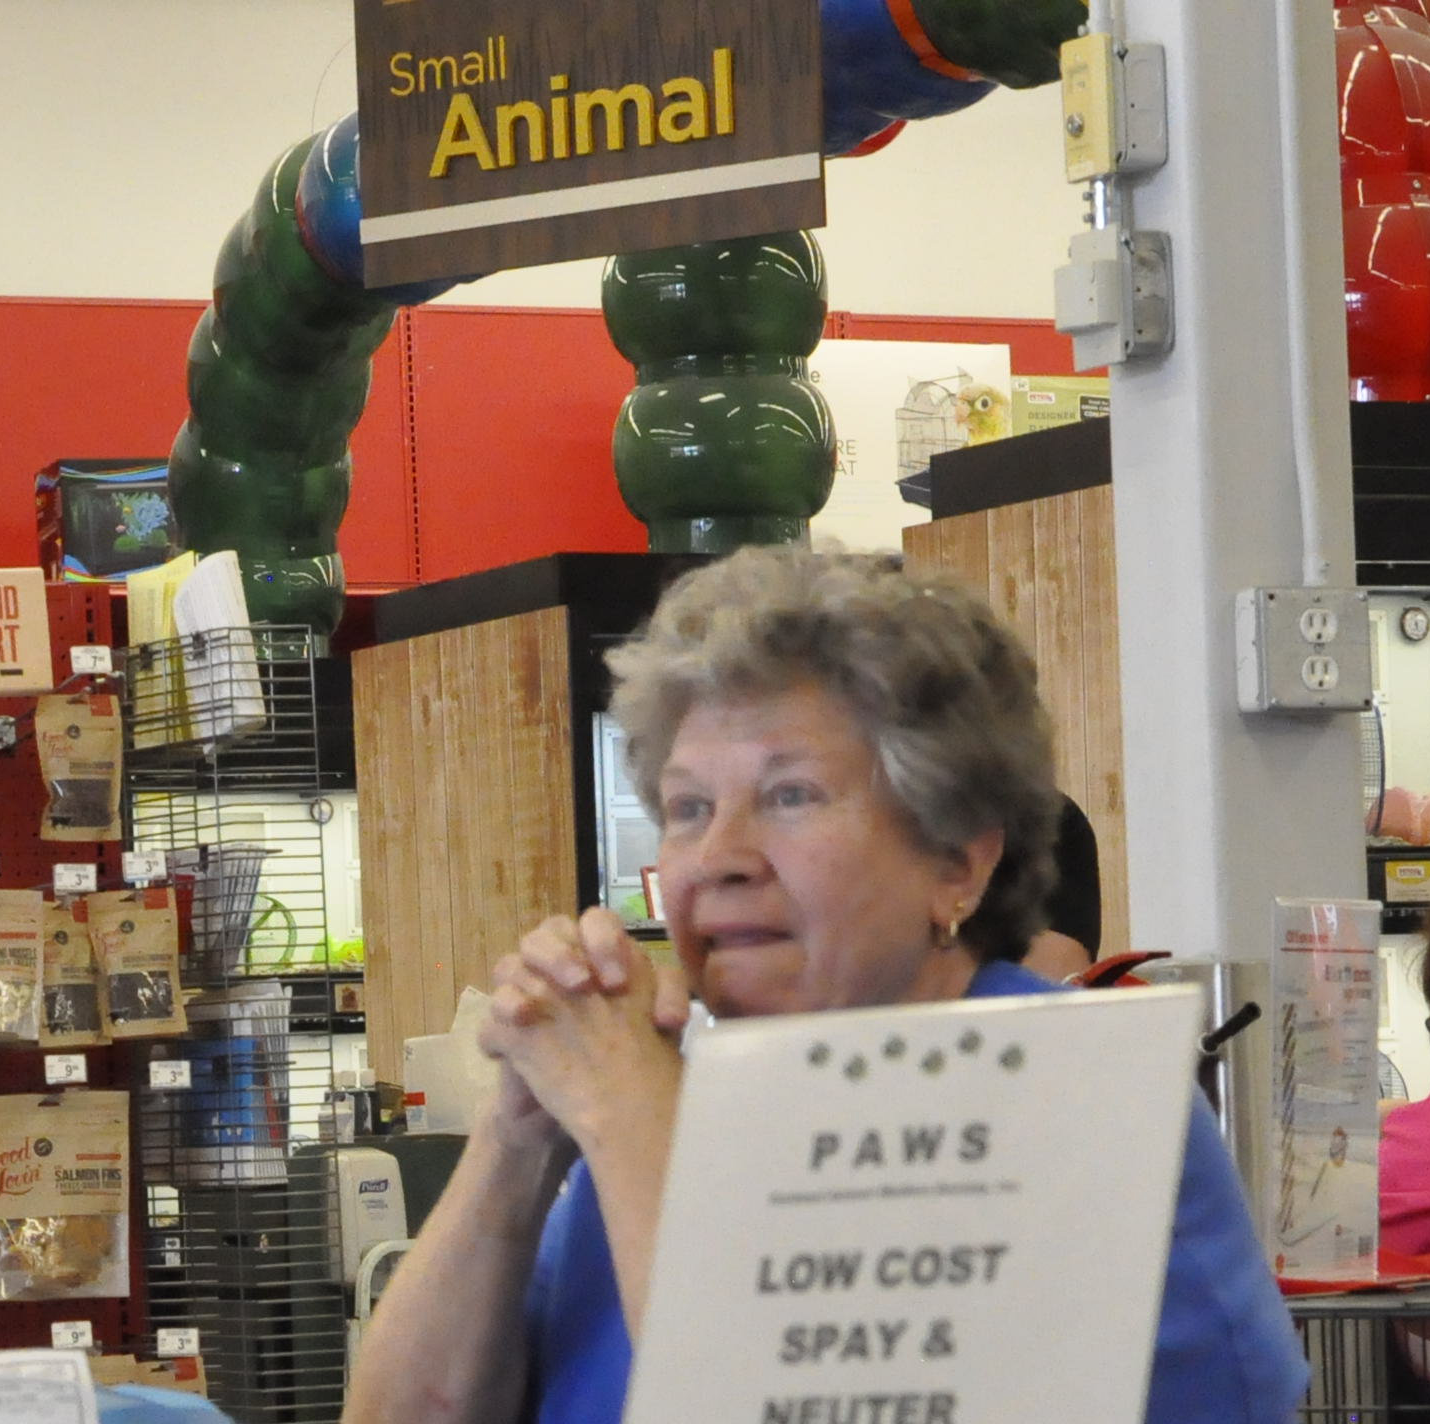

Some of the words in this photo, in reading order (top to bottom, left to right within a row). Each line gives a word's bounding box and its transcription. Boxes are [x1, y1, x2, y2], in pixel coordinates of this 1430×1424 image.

[389, 35, 507, 98] Small
[429, 47, 735, 179] Animal
[1028, 411, 1077, 420] DESIGNER
[55, 1168, 100, 1181] SALMON
[755, 1249, 863, 1295] LOW
[875, 1243, 1011, 1291] COST
[777, 1318, 909, 1365] SPAY
[921, 1319, 957, 1361] &
